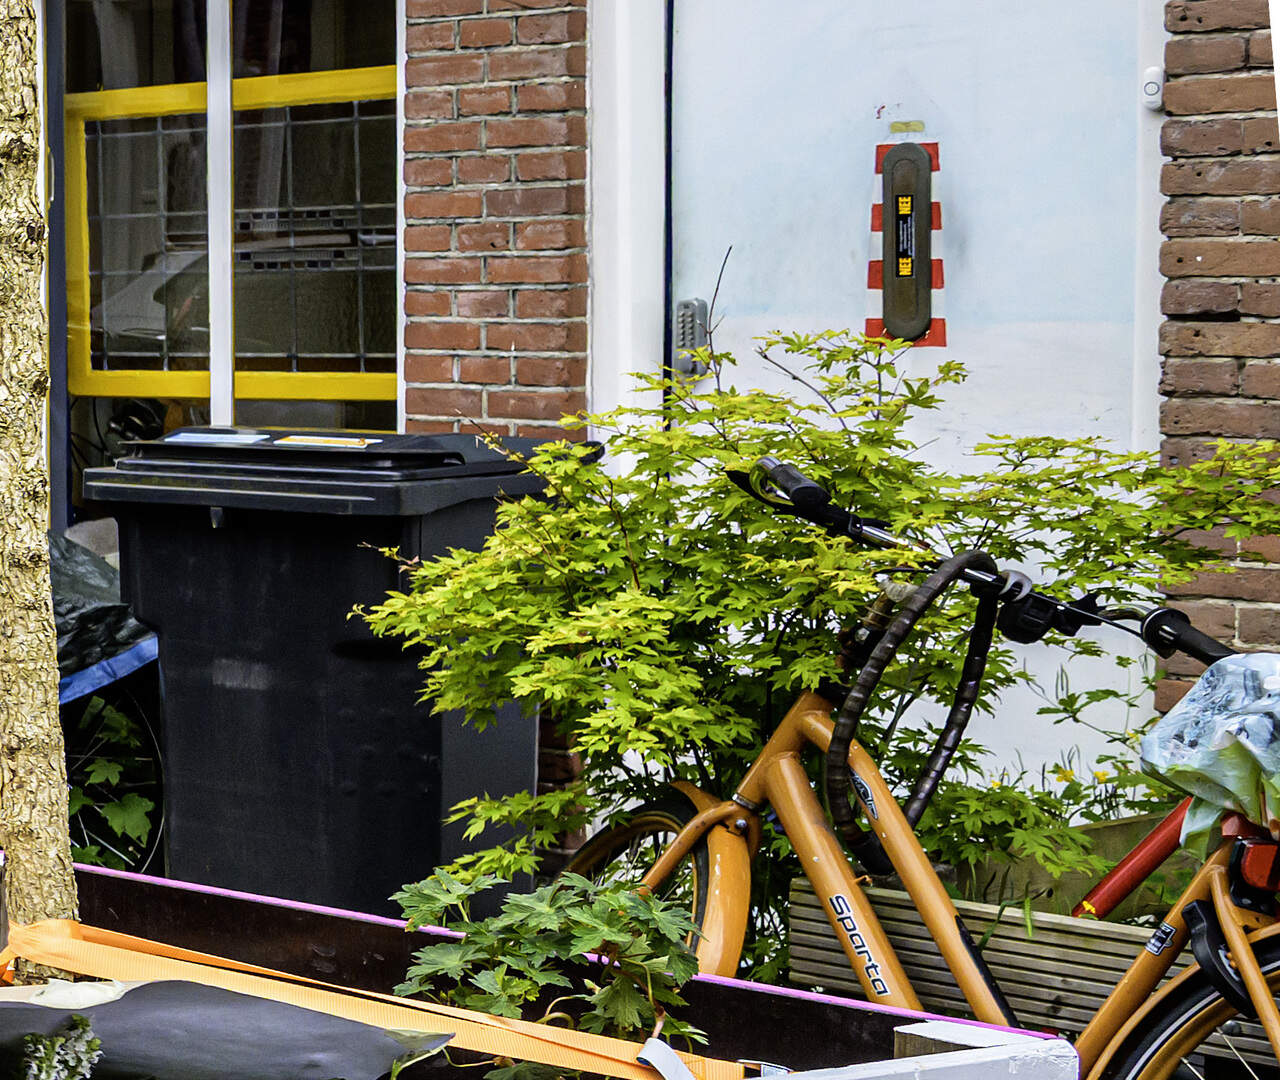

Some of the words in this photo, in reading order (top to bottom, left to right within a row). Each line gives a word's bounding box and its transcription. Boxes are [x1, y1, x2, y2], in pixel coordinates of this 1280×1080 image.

[898, 196, 912, 215] NEE
[898, 257, 912, 276] NEE
[828, 893, 890, 996] Sparta
